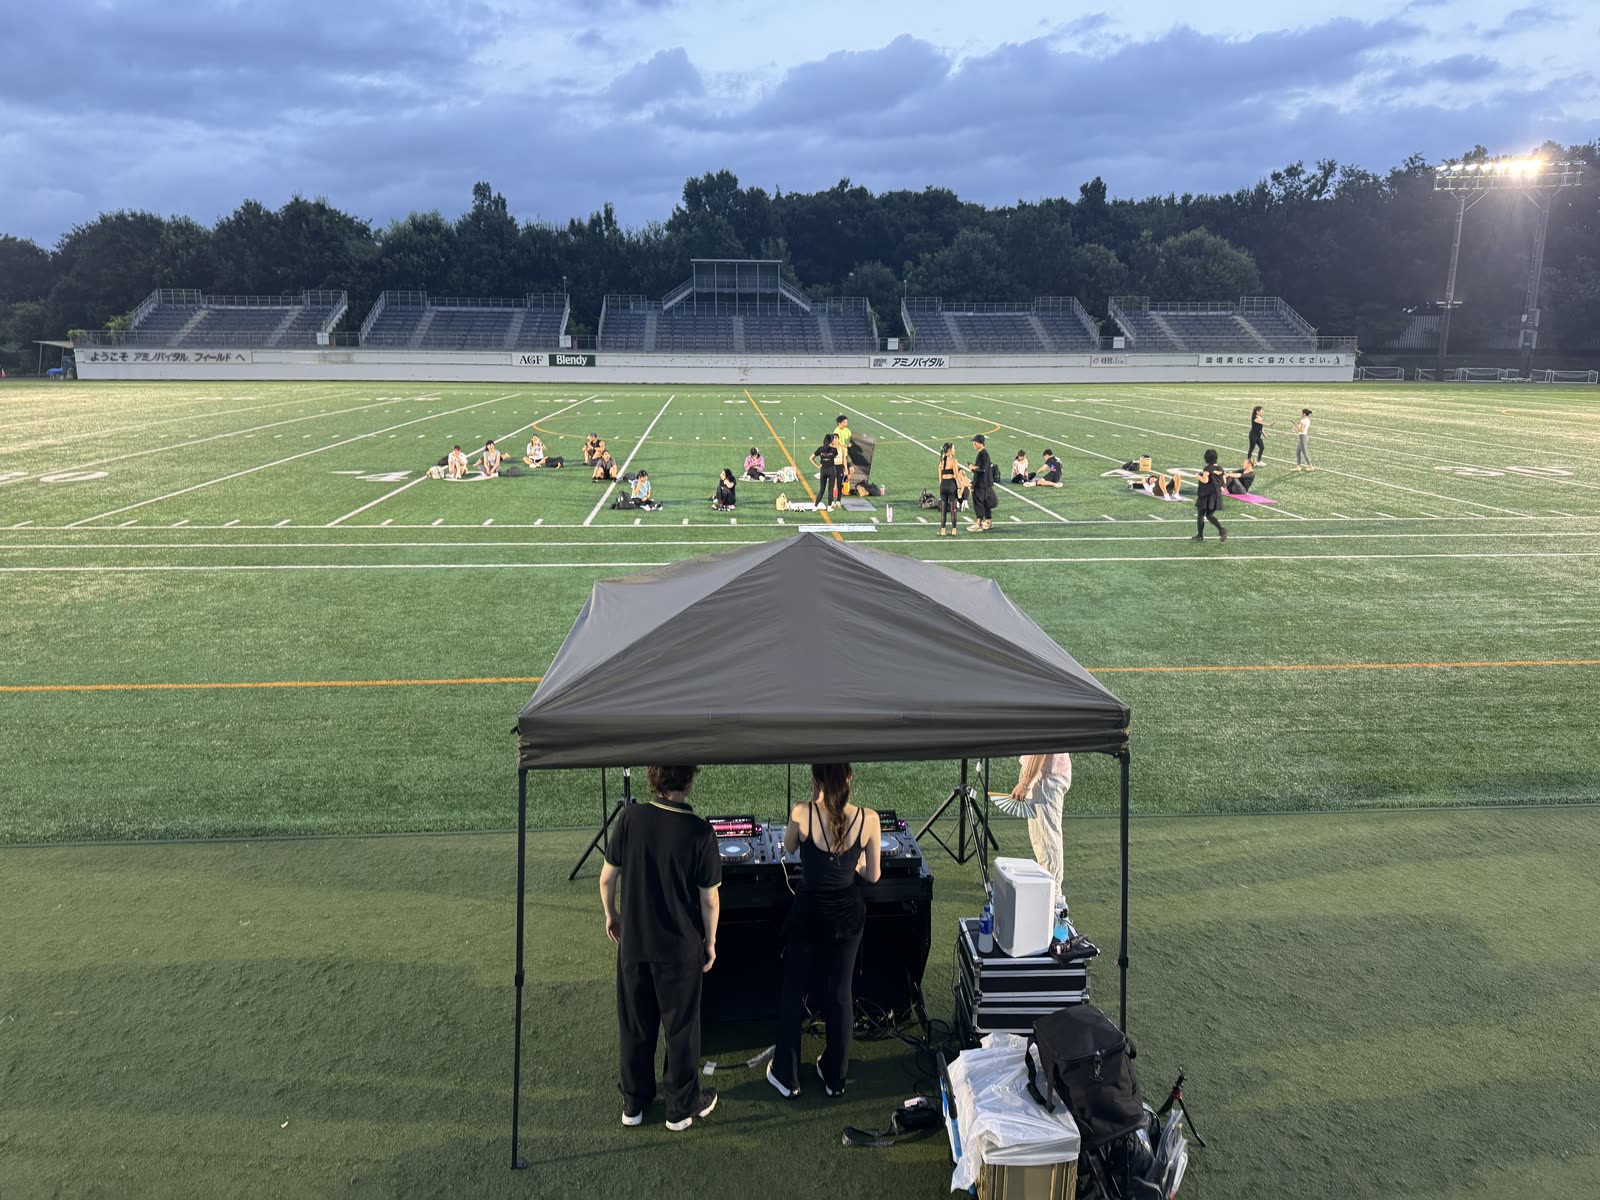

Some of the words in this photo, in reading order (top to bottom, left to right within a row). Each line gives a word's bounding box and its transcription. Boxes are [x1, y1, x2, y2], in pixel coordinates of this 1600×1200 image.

[90, 352, 129, 362] ようこそ
[133, 352, 188, 362] アミノバイタル
[194, 352, 231, 362] フィールド
[235, 353, 245, 361] へ
[519, 355, 543, 365] AGF
[556, 354, 588, 366] Blendy
[891, 357, 945, 367] アミノバイタル
